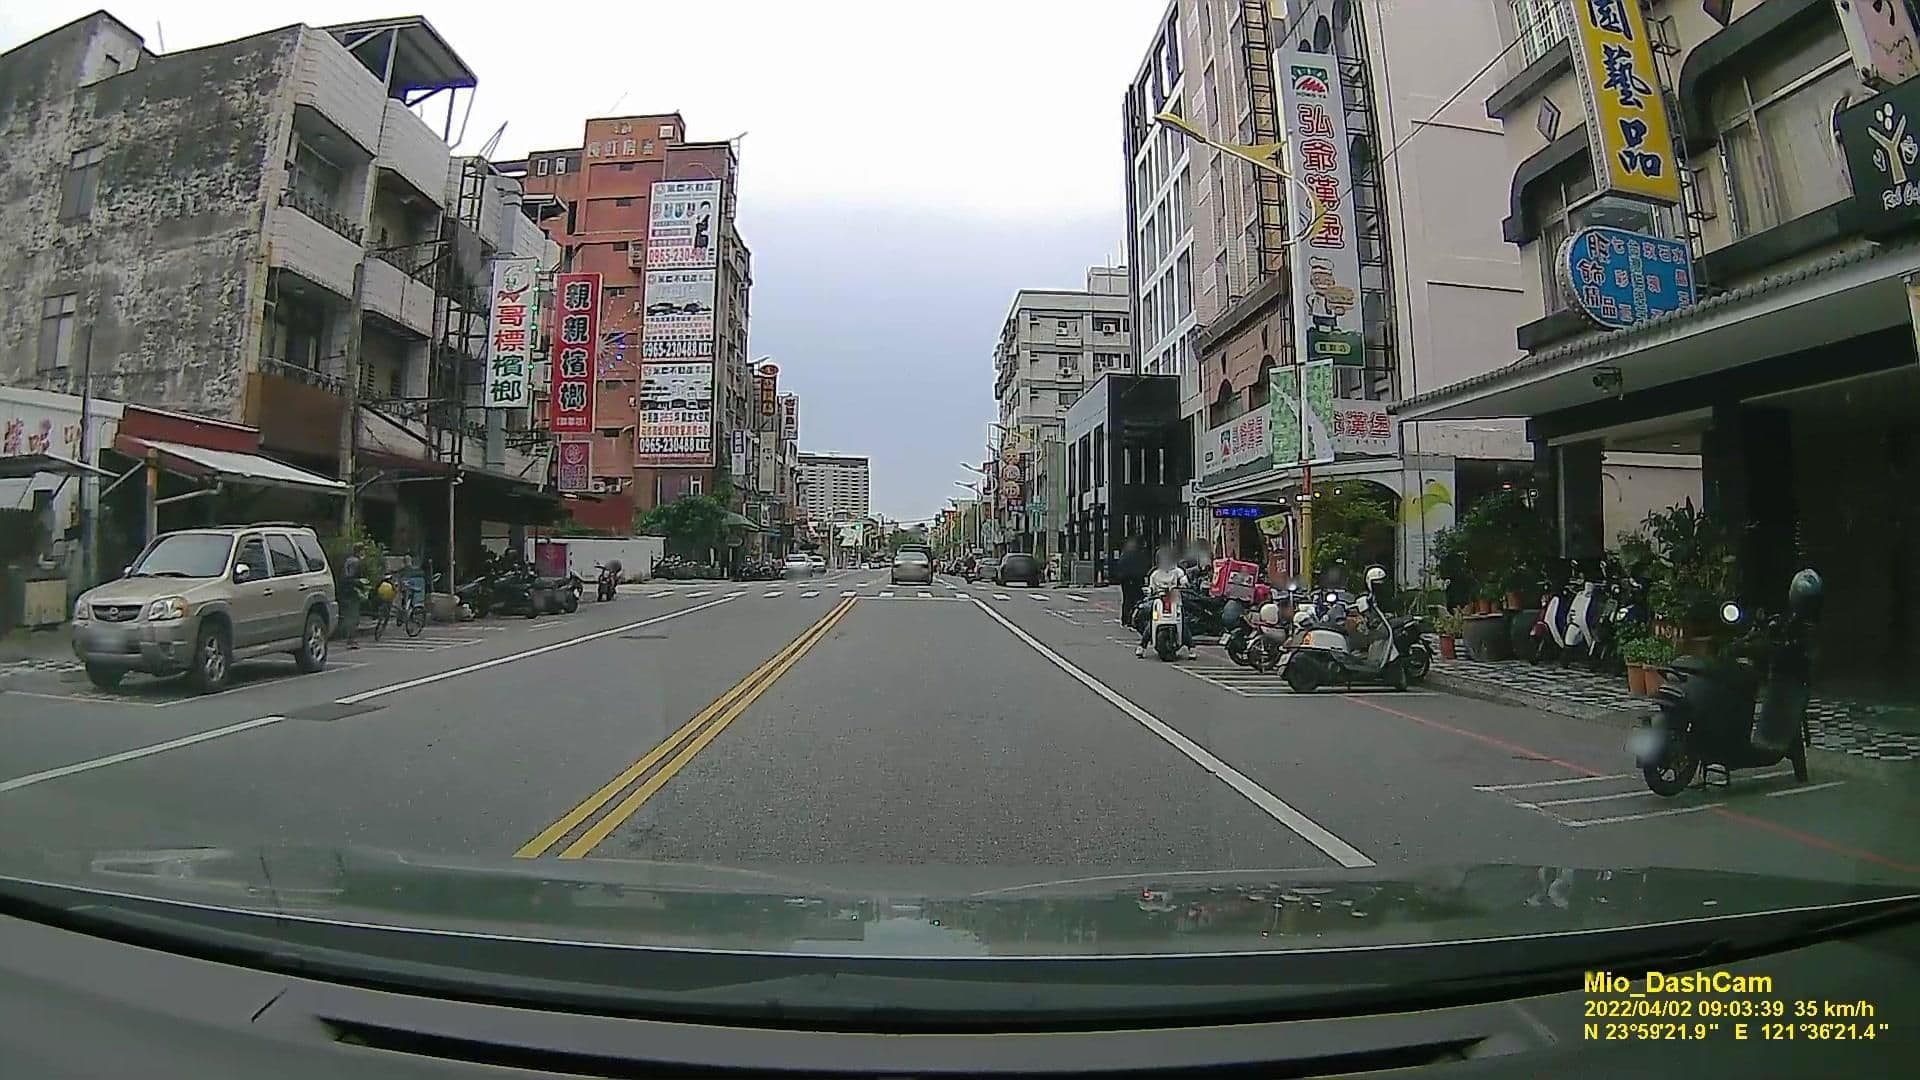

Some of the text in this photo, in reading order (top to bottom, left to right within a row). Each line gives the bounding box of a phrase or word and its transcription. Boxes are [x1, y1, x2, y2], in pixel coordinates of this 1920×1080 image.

[1297, 104, 1344, 249] 弘爺漢堡
[490, 304, 527, 402] 哥標檳榔
[559, 282, 591, 411] 親親檳榔
